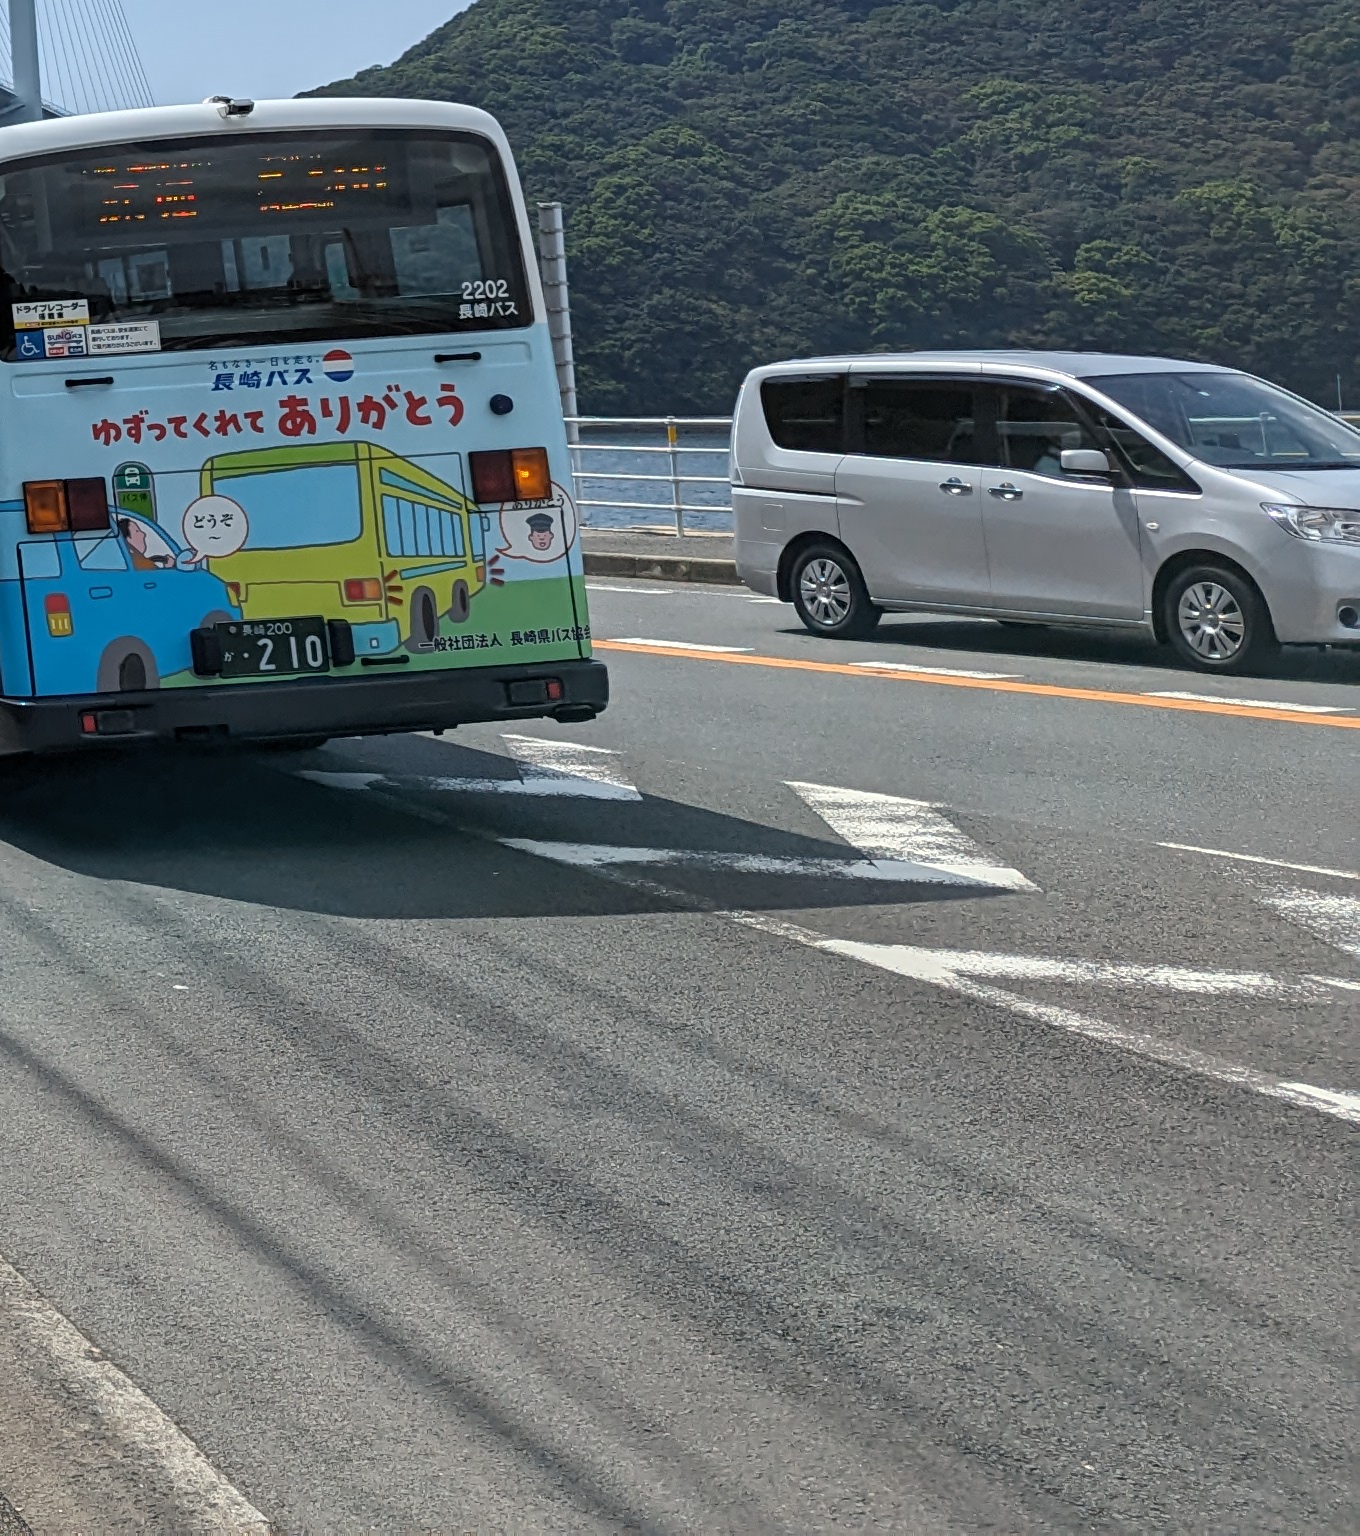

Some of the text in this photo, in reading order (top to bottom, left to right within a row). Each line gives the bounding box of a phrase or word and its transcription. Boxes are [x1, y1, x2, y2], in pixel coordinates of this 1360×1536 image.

[461, 279, 510, 300] 2202
[458, 302, 519, 319] 長崎バス
[211, 368, 314, 391] 長崎バス
[91, 383, 465, 446] ゆずってくれて ありがとう
[193, 513, 234, 529] どうぞ
[419, 632, 503, 652] 一般社団法人
